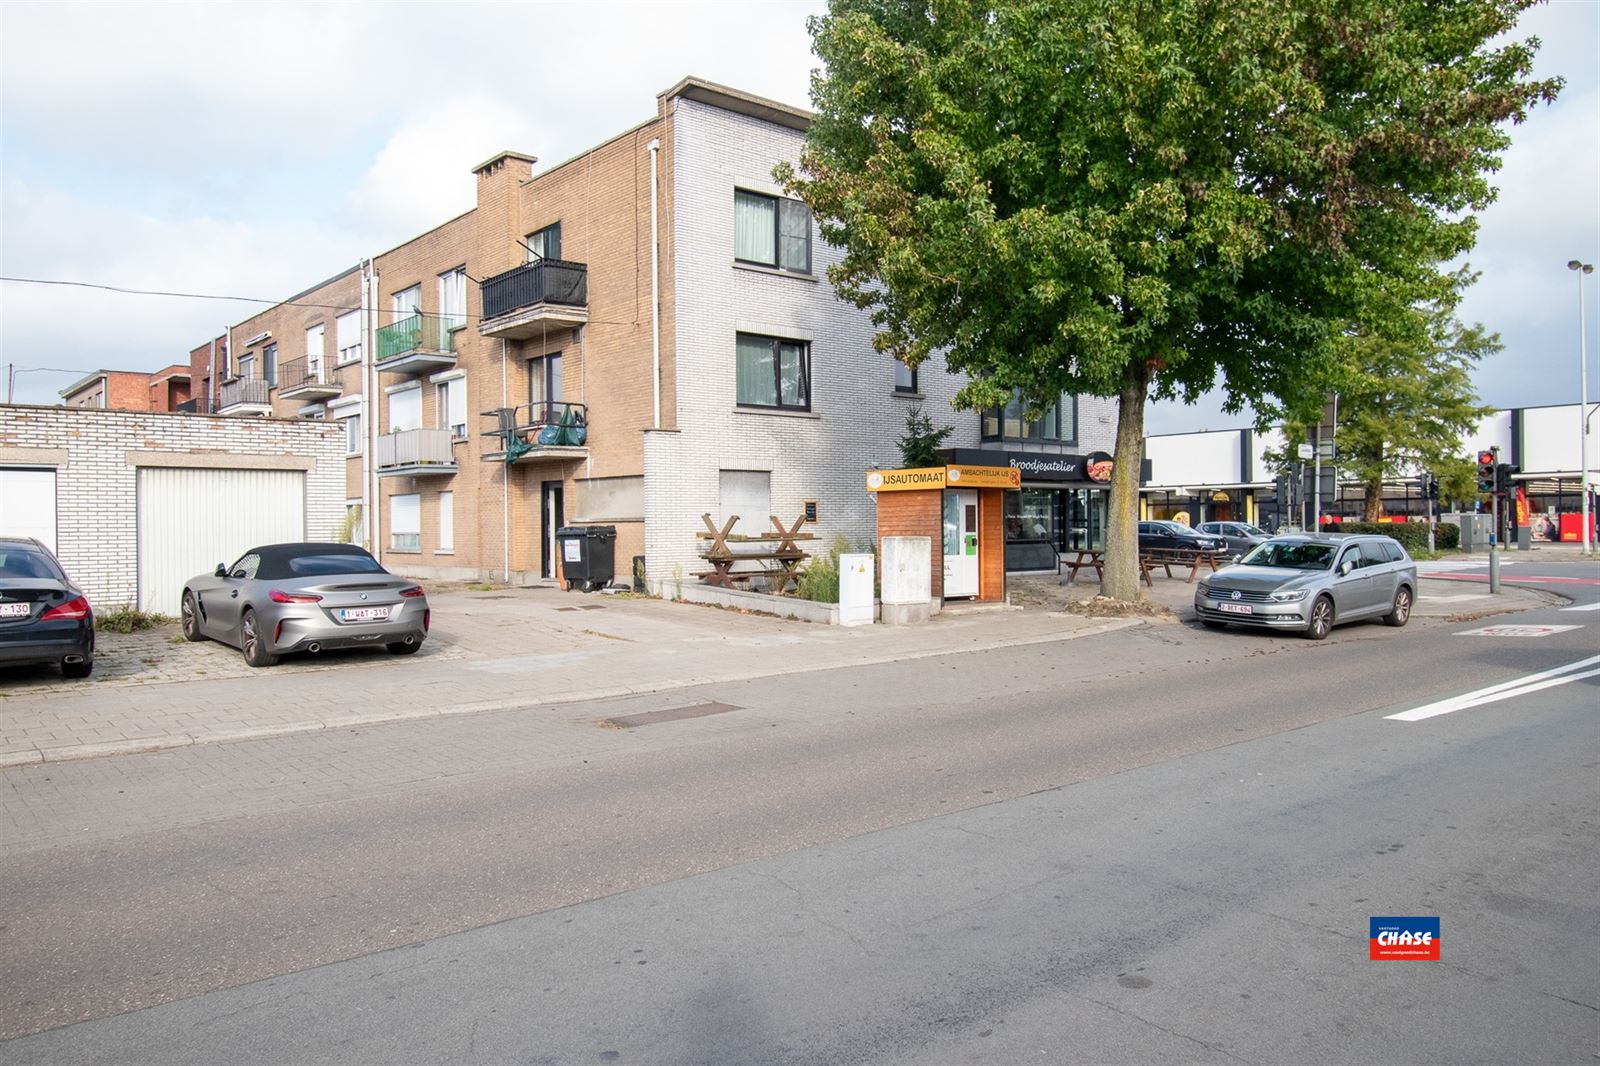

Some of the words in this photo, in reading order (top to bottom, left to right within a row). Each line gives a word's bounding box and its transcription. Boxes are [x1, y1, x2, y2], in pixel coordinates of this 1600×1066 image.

[1010, 459, 1076, 473] Broodjesatelier
[883, 473, 944, 484] IJSAUTOMAAT
[347, 608, 387, 617] 1-WAT-316
